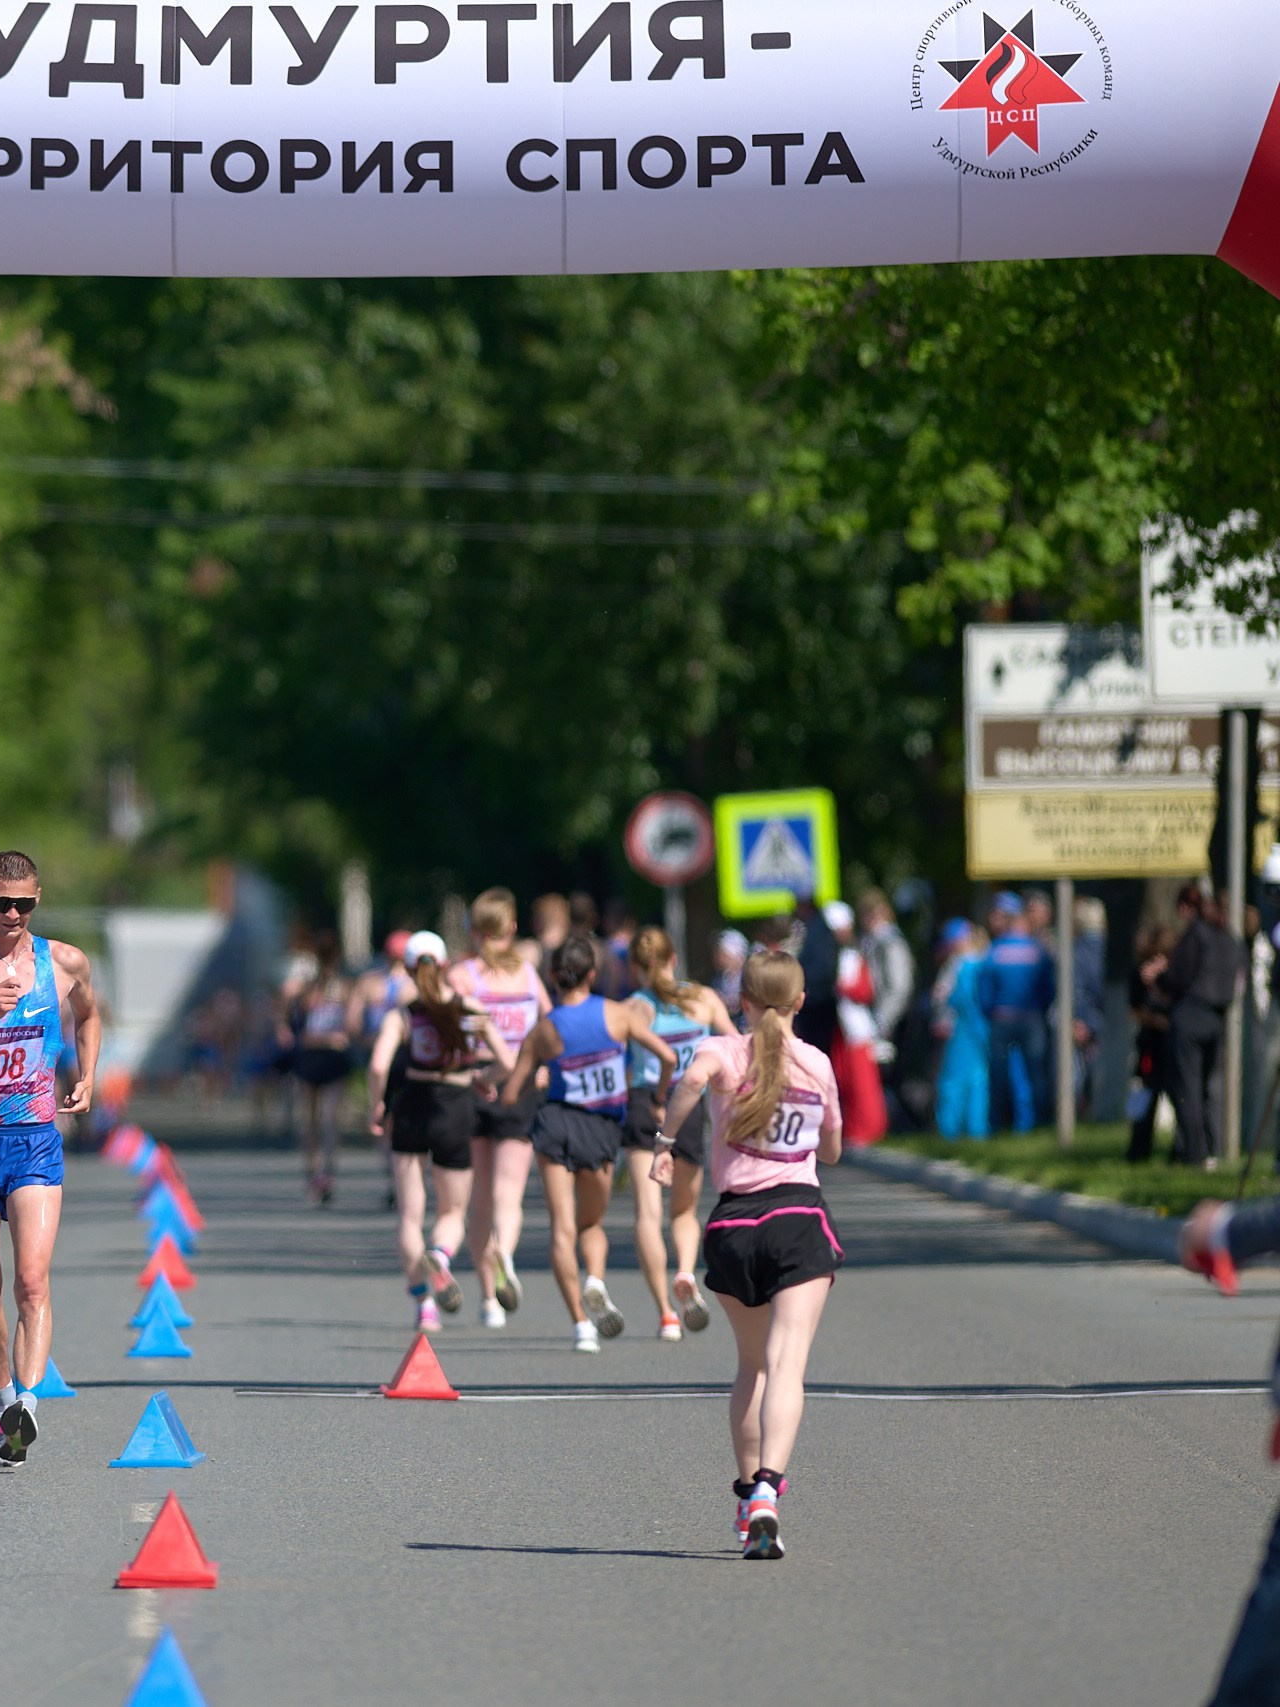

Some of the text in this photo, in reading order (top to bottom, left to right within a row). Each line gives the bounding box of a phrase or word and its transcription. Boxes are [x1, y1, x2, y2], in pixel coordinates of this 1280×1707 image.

[910, 65, 925, 111] Центр
[1099, 46, 1113, 101] команд
[989, 109, 1036, 124] ЦСП
[505, 132, 866, 193] СПОРТА
[932, 128, 1099, 180] Удмуртской Республики
[579, 1067, 616, 1098] 118
[764, 1108, 805, 1146] 30
